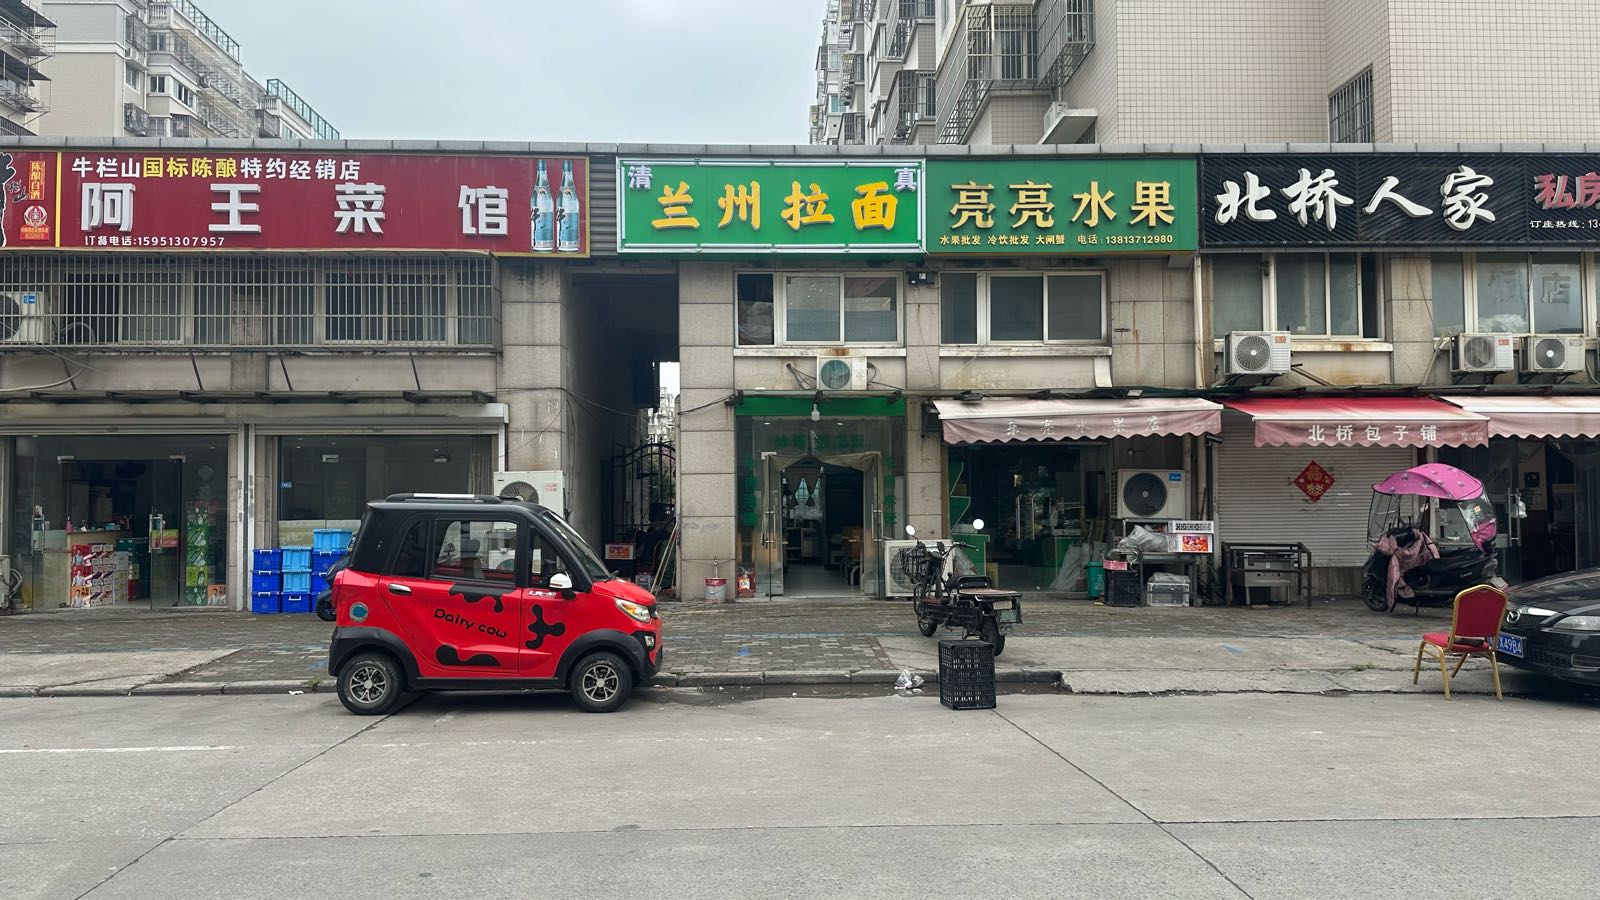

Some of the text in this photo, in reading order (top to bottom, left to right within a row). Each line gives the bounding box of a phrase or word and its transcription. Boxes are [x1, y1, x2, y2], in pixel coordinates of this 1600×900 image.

[71, 157, 361, 180] 牛栏山国标陈酿特约经销店
[628, 165, 652, 189] 清
[894, 168, 917, 191] 真
[81, 181, 509, 236] 阿王菜馆
[651, 180, 898, 231] 兰州拉面
[950, 180, 1176, 229] 亮亮水果
[1215, 165, 1496, 231] 北桥人家
[939, 235, 981, 246] 水果批发
[987, 235, 1030, 246] 冷饮批发
[1308, 424, 1437, 441] 北桥包子铺
[433, 607, 508, 639] Dairy cow
